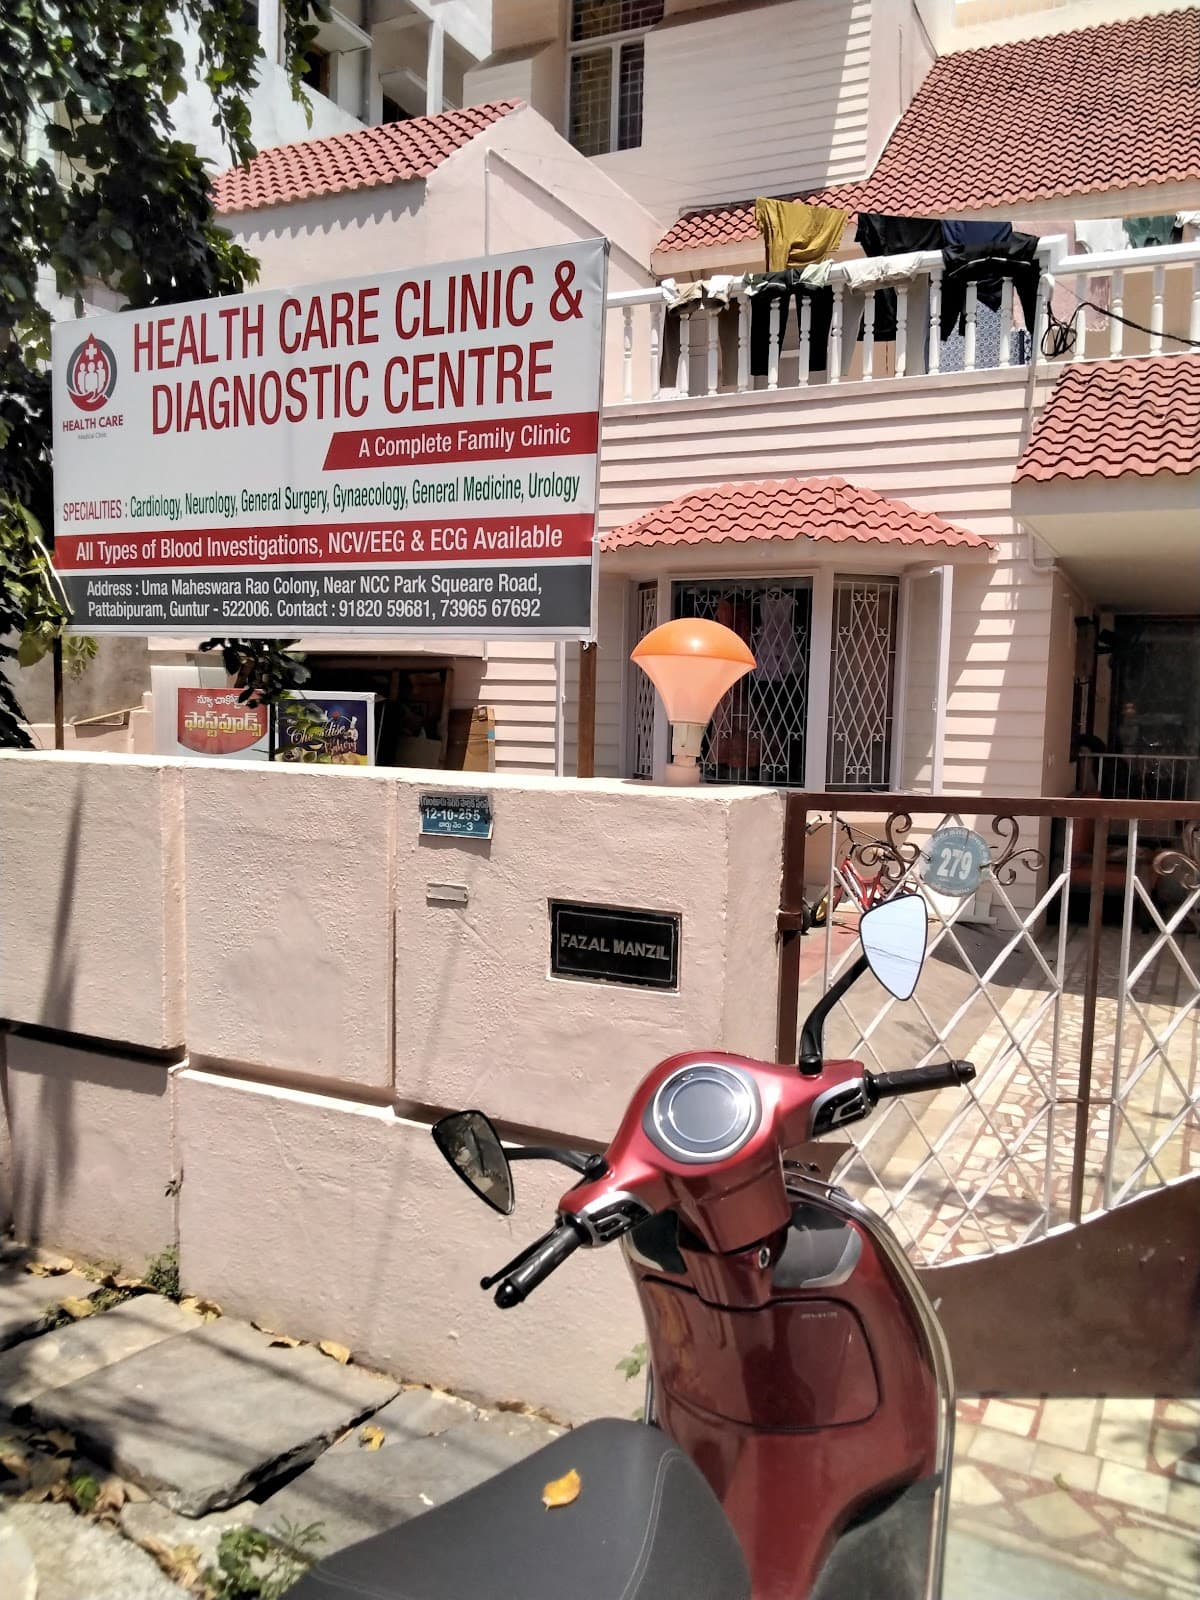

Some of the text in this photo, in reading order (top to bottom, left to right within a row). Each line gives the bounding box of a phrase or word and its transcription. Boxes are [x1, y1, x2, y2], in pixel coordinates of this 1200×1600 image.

[133, 260, 584, 373] HEALTH CARE CLINIC &
[152, 340, 554, 435] DIAGNOSTIC CENTRE
[62, 414, 124, 432] HEALTH CARE
[358, 422, 571, 459] A Complete Family Clinic
[63, 499, 122, 521] SPECIALITIES
[130, 495, 183, 521] Cardiology,
[185, 491, 238, 518] Neurology,
[241, 487, 281, 513] General
[284, 486, 330, 515] Surgery,
[333, 481, 408, 513] Gynaecology,
[412, 477, 459, 504] General
[463, 474, 524, 502] Medicine,
[528, 471, 581, 502] Urology
[76, 524, 563, 565] All Types of Blood Investigations, NCV/EEG & ECG Available
[87, 579, 132, 597] Address
[141, 579, 168, 596] Uma
[171, 578, 241, 595] Maheswara
[245, 577, 269, 594] Rao
[273, 576, 320, 597] Colony,
[323, 576, 356, 594] Near
[360, 575, 390, 593] NCC
[394, 575, 426, 593] Park
[431, 574, 493, 596] Squeare
[498, 573, 543, 595] Road,
[88, 602, 167, 620] Pattabipuram,
[169, 601, 210, 617] Guntur
[222, 600, 273, 617] 522006.
[277, 600, 328, 617] Contact
[339, 600, 382, 617] 91820
[386, 599, 436, 621] 59681,
[440, 599, 487, 617] 73965
[491, 598, 540, 617] 67692
[425, 808, 481, 821] 12-10-255
[936, 847, 973, 880] 279
[560, 933, 670, 961] FAZAL MANZIL
